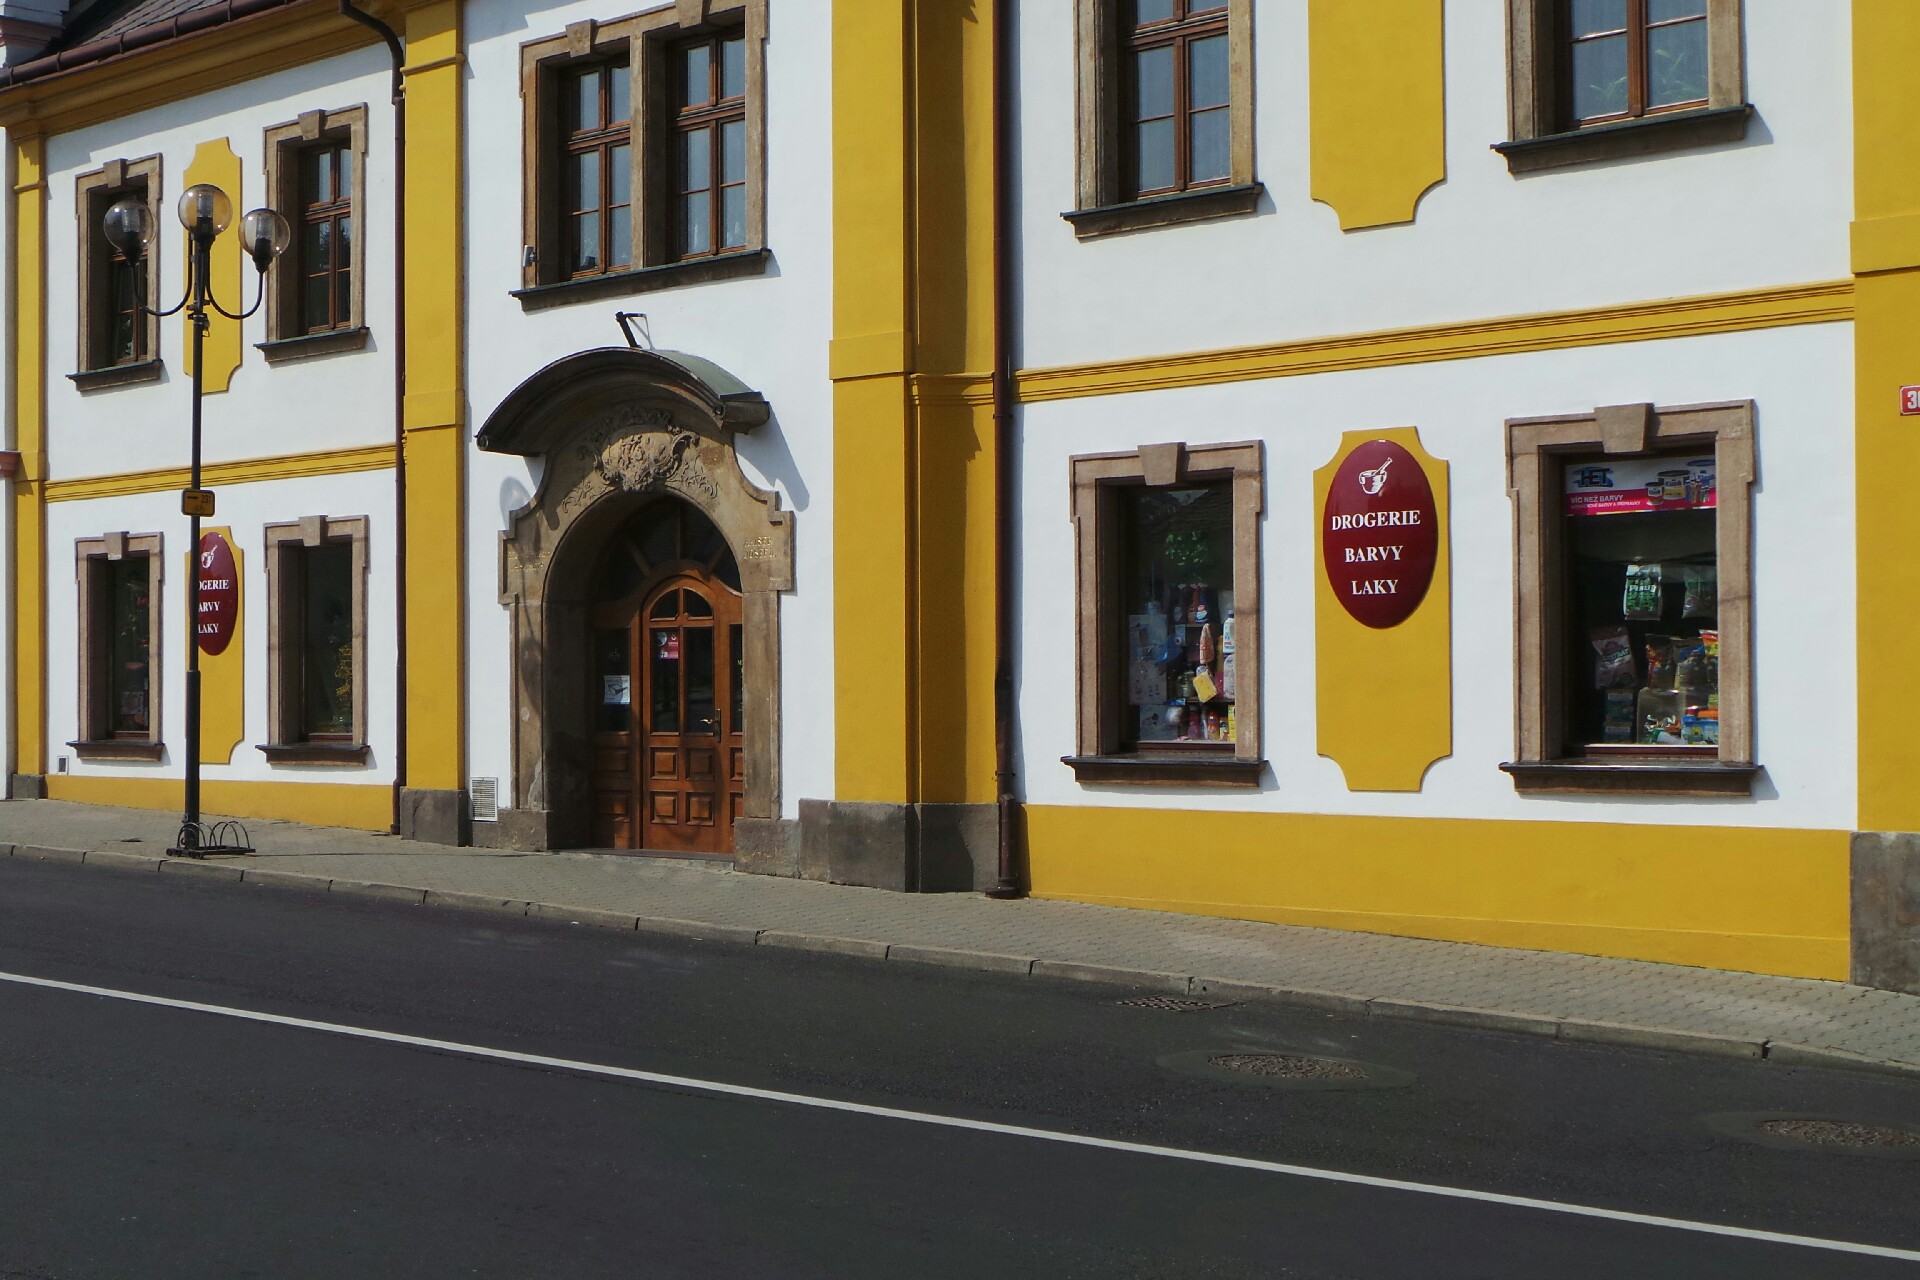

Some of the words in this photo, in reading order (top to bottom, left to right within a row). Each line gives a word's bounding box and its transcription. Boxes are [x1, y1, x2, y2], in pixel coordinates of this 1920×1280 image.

[1907, 390, 1920, 409] 3
[1580, 468, 1611, 486] HET
[1332, 510, 1421, 531] DROGERIE
[1344, 545, 1404, 563] BARVY
[1351, 579, 1399, 596] LAKY
[198, 601, 220, 613] ARVY
[198, 623, 219, 634] LAKY
